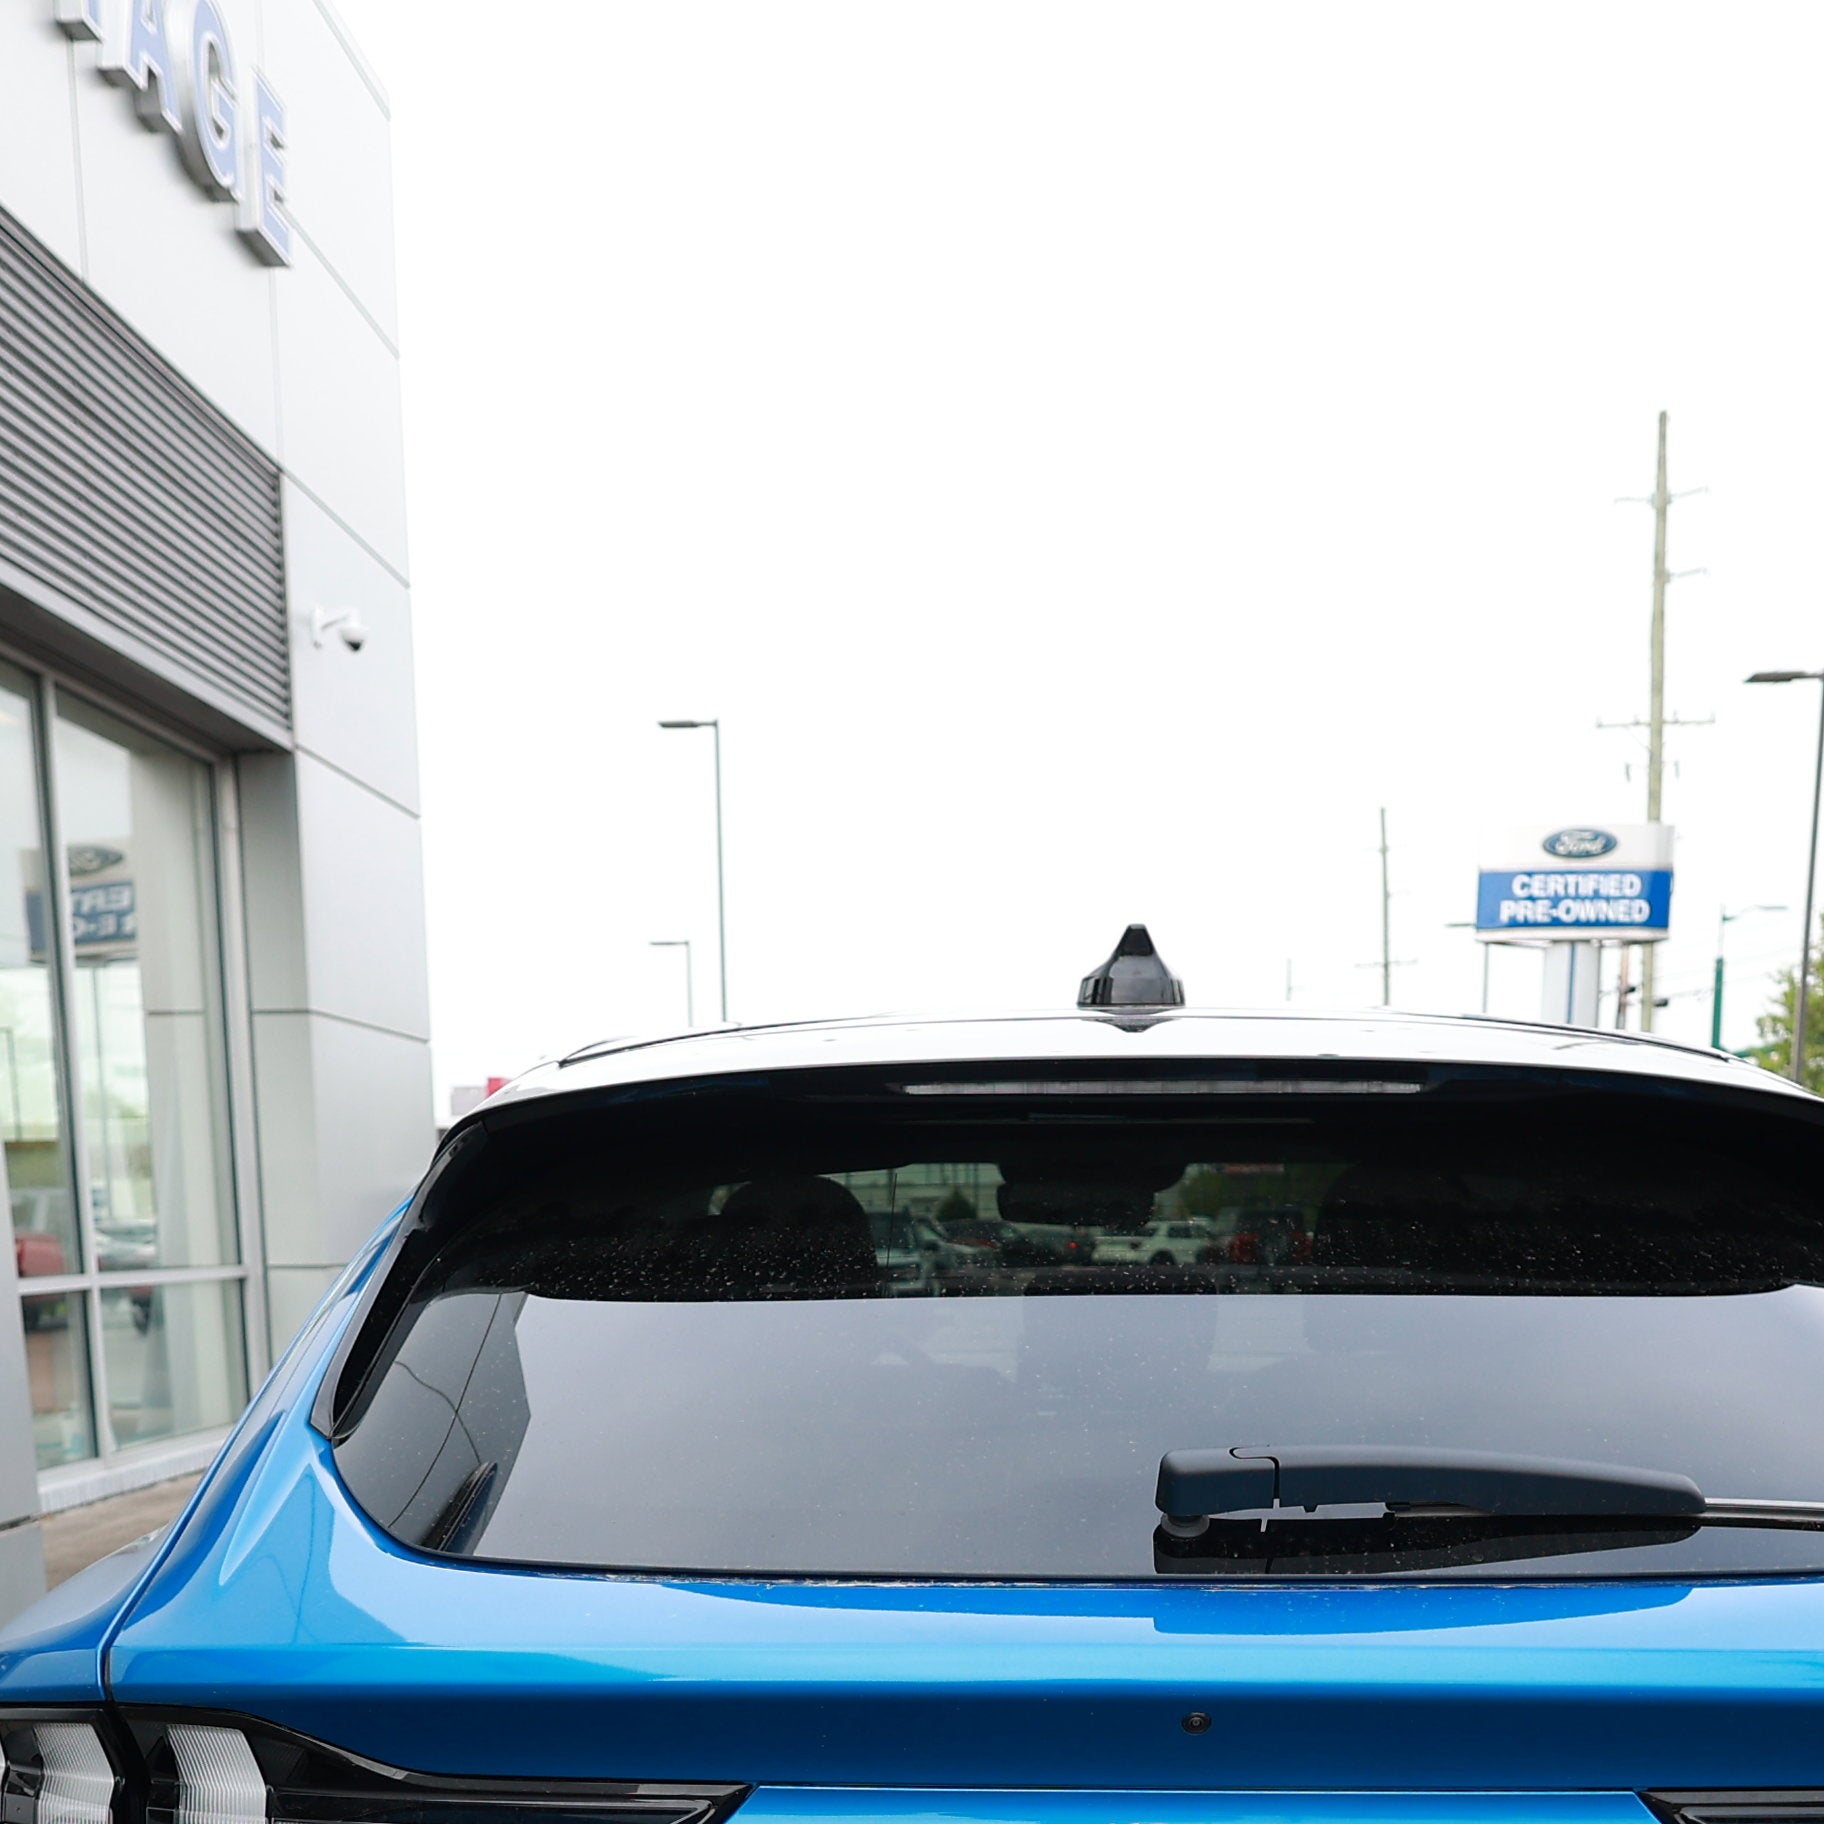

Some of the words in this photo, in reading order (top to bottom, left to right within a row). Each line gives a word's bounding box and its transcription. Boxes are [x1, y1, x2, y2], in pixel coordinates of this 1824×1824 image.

[55, 0, 293, 267] AGE
[1511, 873, 1642, 898] CERTIFIED
[1499, 899, 1651, 923] PRE-OWNED
